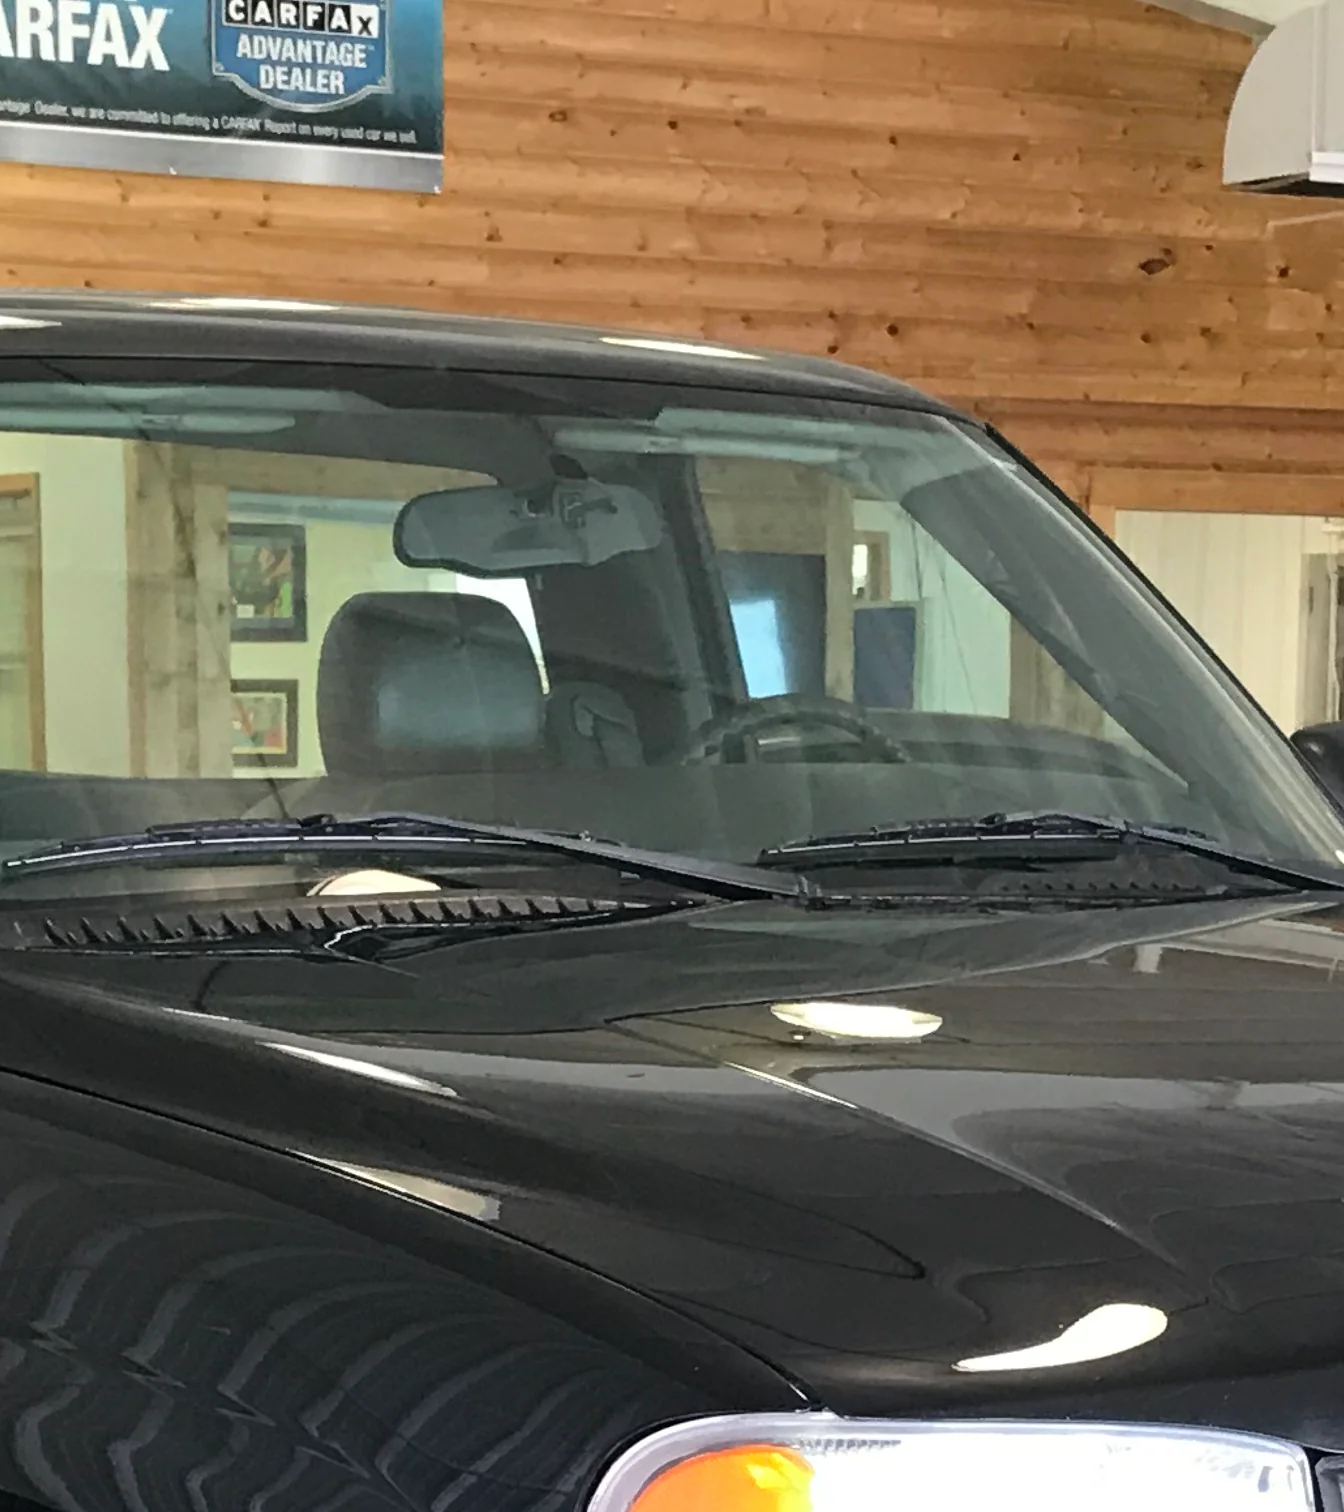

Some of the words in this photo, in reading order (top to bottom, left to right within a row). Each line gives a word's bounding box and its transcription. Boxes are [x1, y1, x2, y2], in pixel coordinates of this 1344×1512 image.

[227, 0, 374, 37] CARFAX
[236, 33, 368, 68] ADVANTAGE
[259, 64, 345, 95] DEALER
